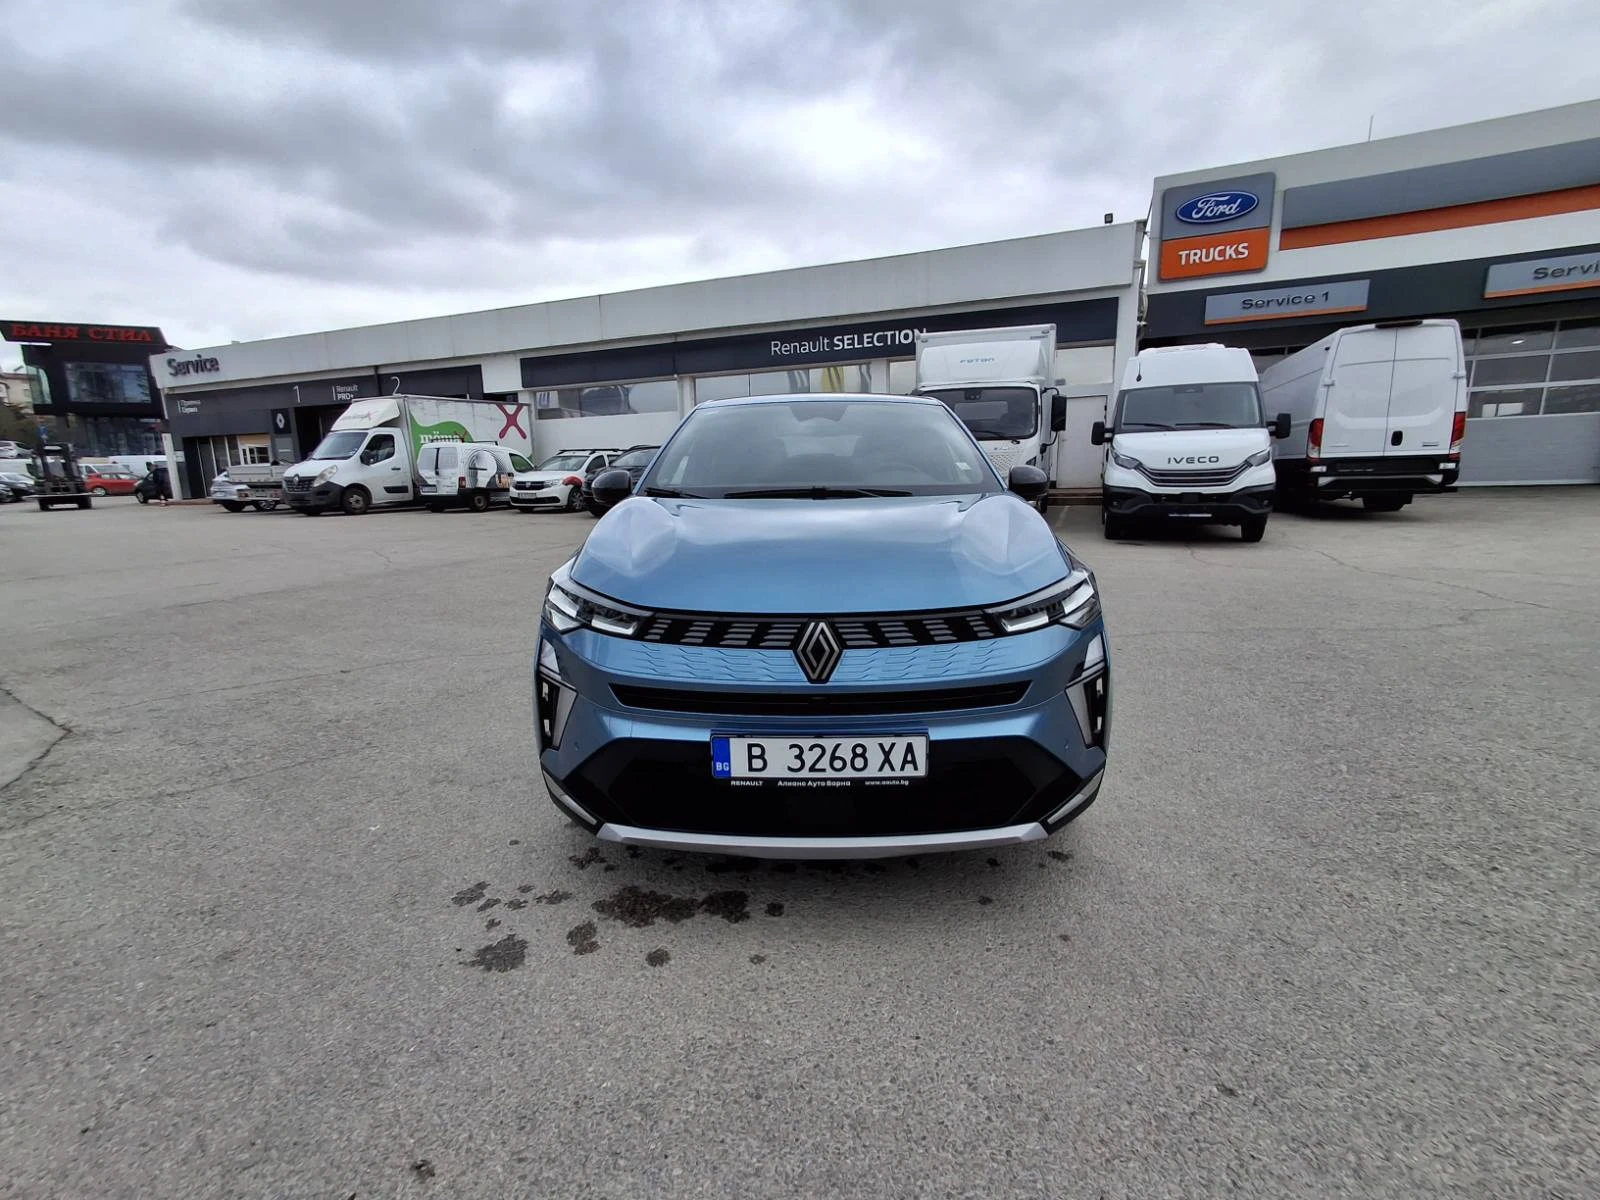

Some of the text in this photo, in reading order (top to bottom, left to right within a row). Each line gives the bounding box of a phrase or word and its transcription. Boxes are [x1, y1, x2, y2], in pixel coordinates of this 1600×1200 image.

[1191, 195, 1242, 219] Ford
[1178, 242, 1249, 266] TRUCKS
[1241, 291, 1330, 310] Service 1
[11, 323, 153, 342] БАНЯ СТИЛ
[770, 336, 830, 356] Renault
[166, 353, 220, 377] Service
[1167, 455, 1220, 465] IVECO
[715, 762, 730, 772] BG
[746, 741, 919, 773] B 3268 XA
